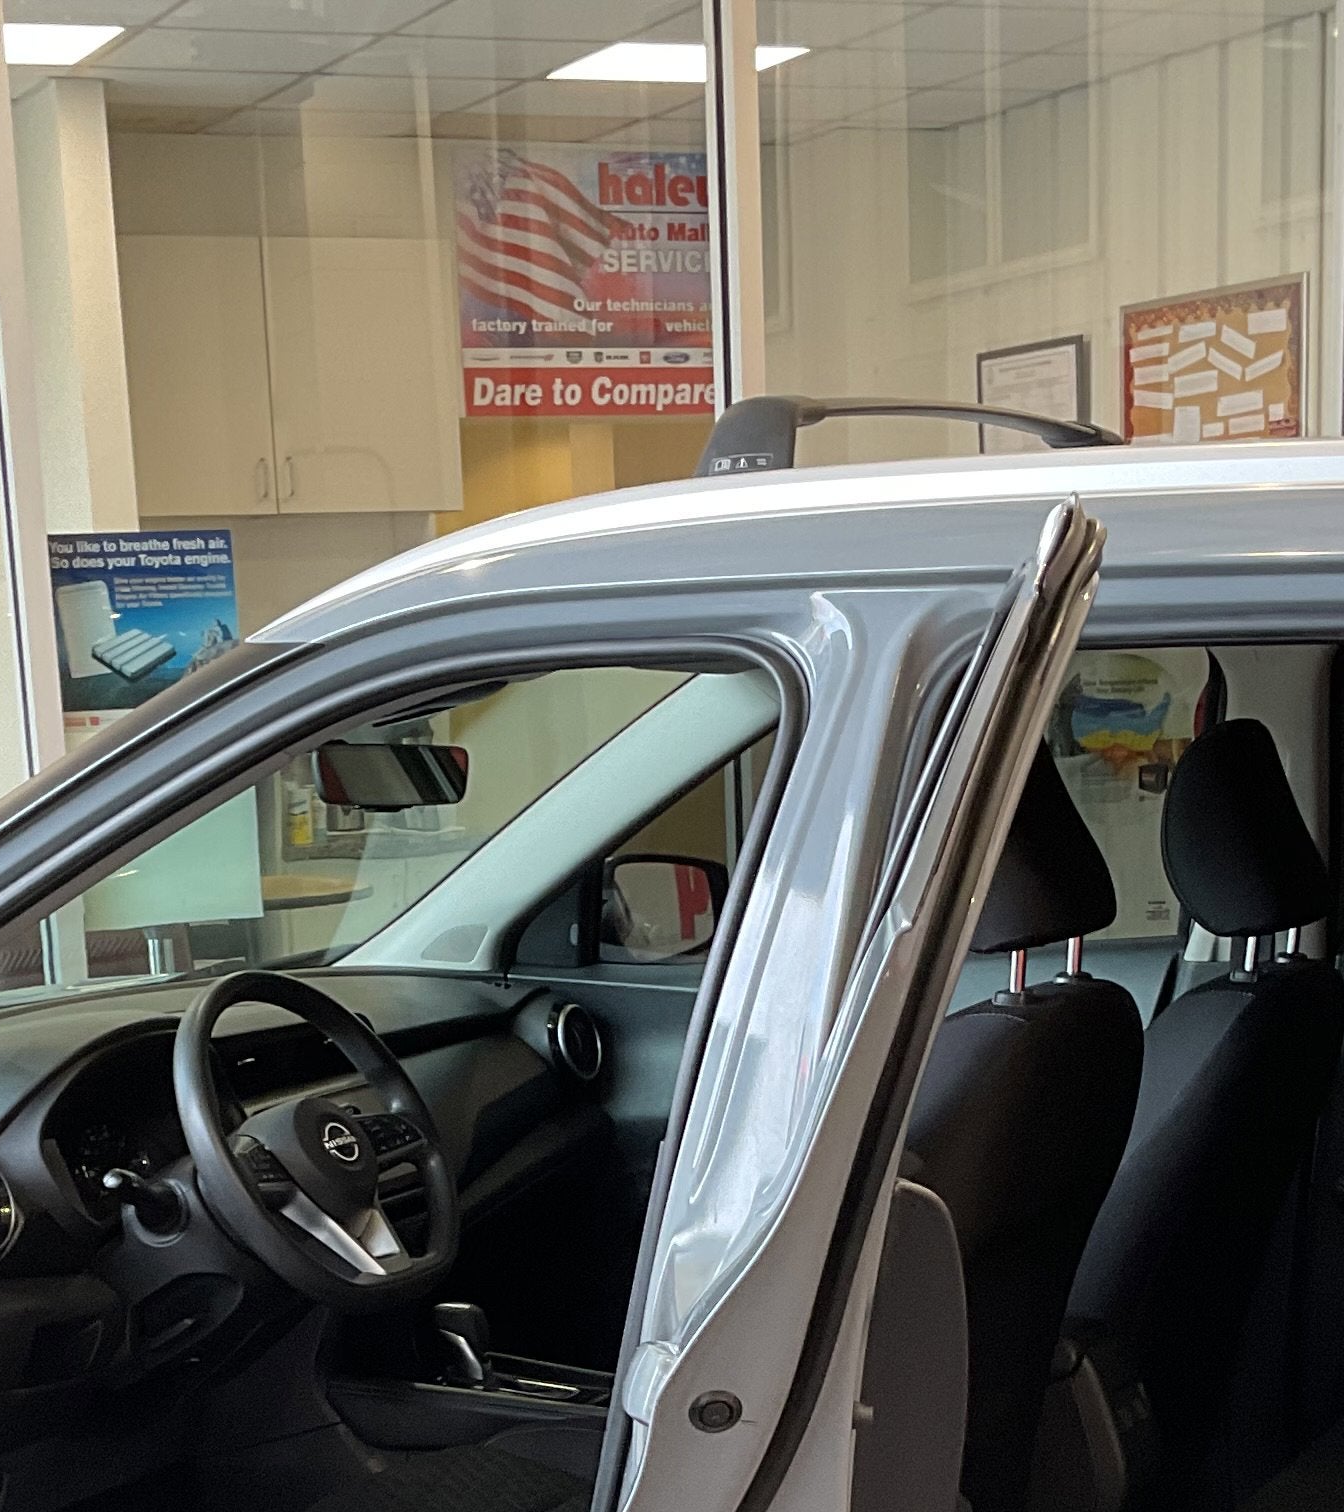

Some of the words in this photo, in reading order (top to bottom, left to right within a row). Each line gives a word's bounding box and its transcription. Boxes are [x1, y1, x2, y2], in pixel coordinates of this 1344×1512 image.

[573, 299, 602, 312] Our
[607, 298, 695, 312] technicians
[472, 318, 527, 334] factory
[531, 318, 587, 332] trained
[591, 318, 614, 333] for
[473, 377, 543, 406] Dare
[552, 377, 582, 406] to
[591, 376, 715, 411] Compare
[48, 541, 73, 554] You
[76, 541, 101, 553] like
[102, 540, 117, 552] to
[119, 539, 170, 552] breathe
[172, 537, 206, 550] fresh
[208, 537, 229, 549] air.
[51, 556, 70, 569] So
[72, 556, 105, 569] does
[106, 556, 136, 570] your
[138, 553, 182, 569] Toyota
[184, 552, 232, 567] engine.
